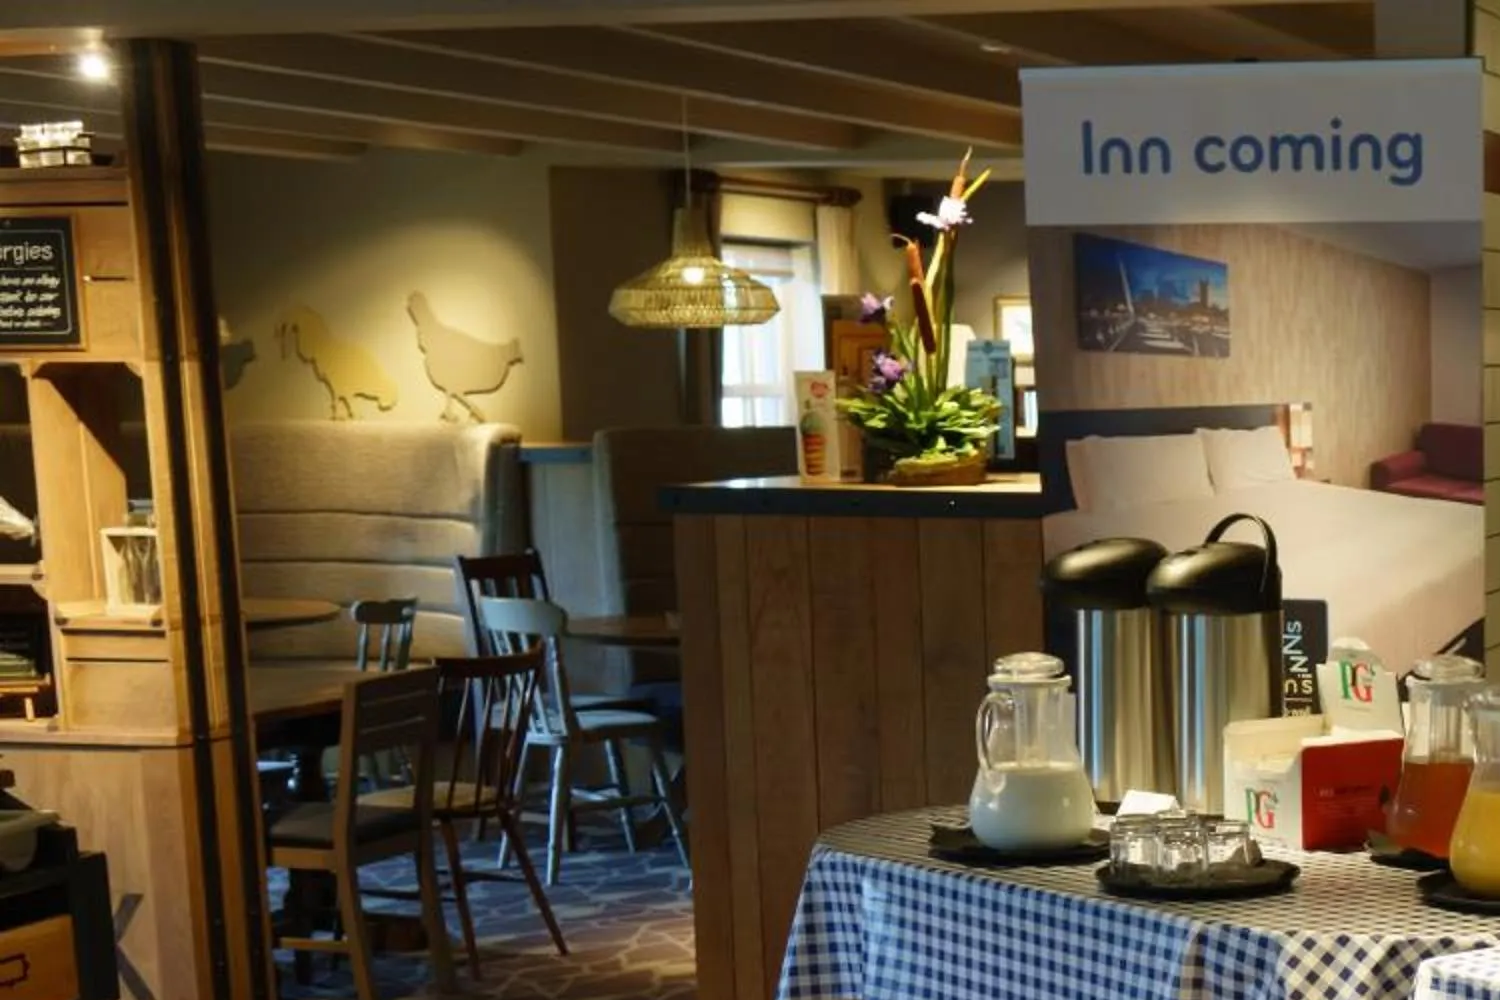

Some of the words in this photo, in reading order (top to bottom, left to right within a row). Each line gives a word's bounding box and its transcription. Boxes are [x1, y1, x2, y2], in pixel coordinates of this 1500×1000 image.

[1082, 119, 1172, 175] Inn
[1194, 118, 1423, 186] coming
[0, 241, 54, 265] rgies
